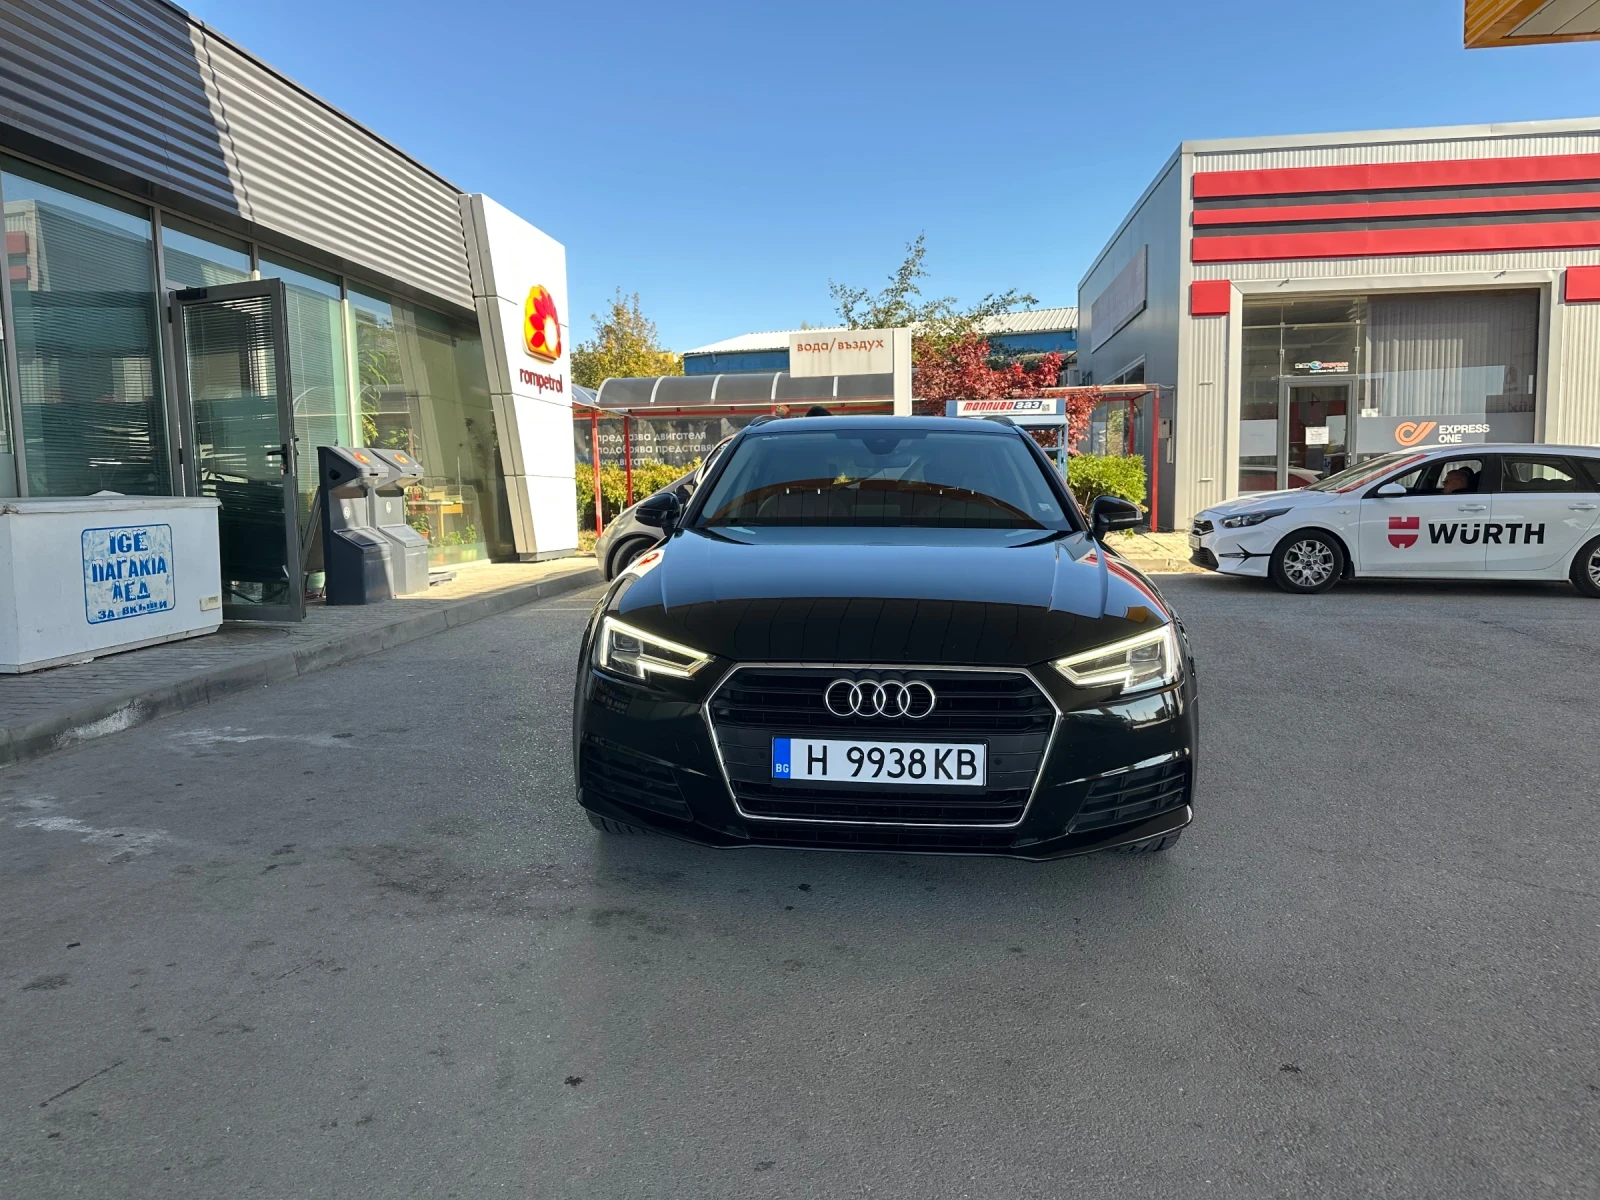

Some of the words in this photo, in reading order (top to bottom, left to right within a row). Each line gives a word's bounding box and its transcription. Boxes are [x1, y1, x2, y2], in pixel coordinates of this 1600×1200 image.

[519, 368, 563, 394] rompetrol
[653, 431, 706, 442] двигателя
[1438, 424, 1490, 434] EXPRESS
[1438, 434, 1462, 443] ONE
[109, 529, 149, 554] ICE
[1428, 523, 1545, 544] WÜRTH
[112, 578, 151, 603] ЛЕД
[97, 609, 115, 620] ЗА
[775, 763, 789, 773] BG
[807, 744, 828, 776] H
